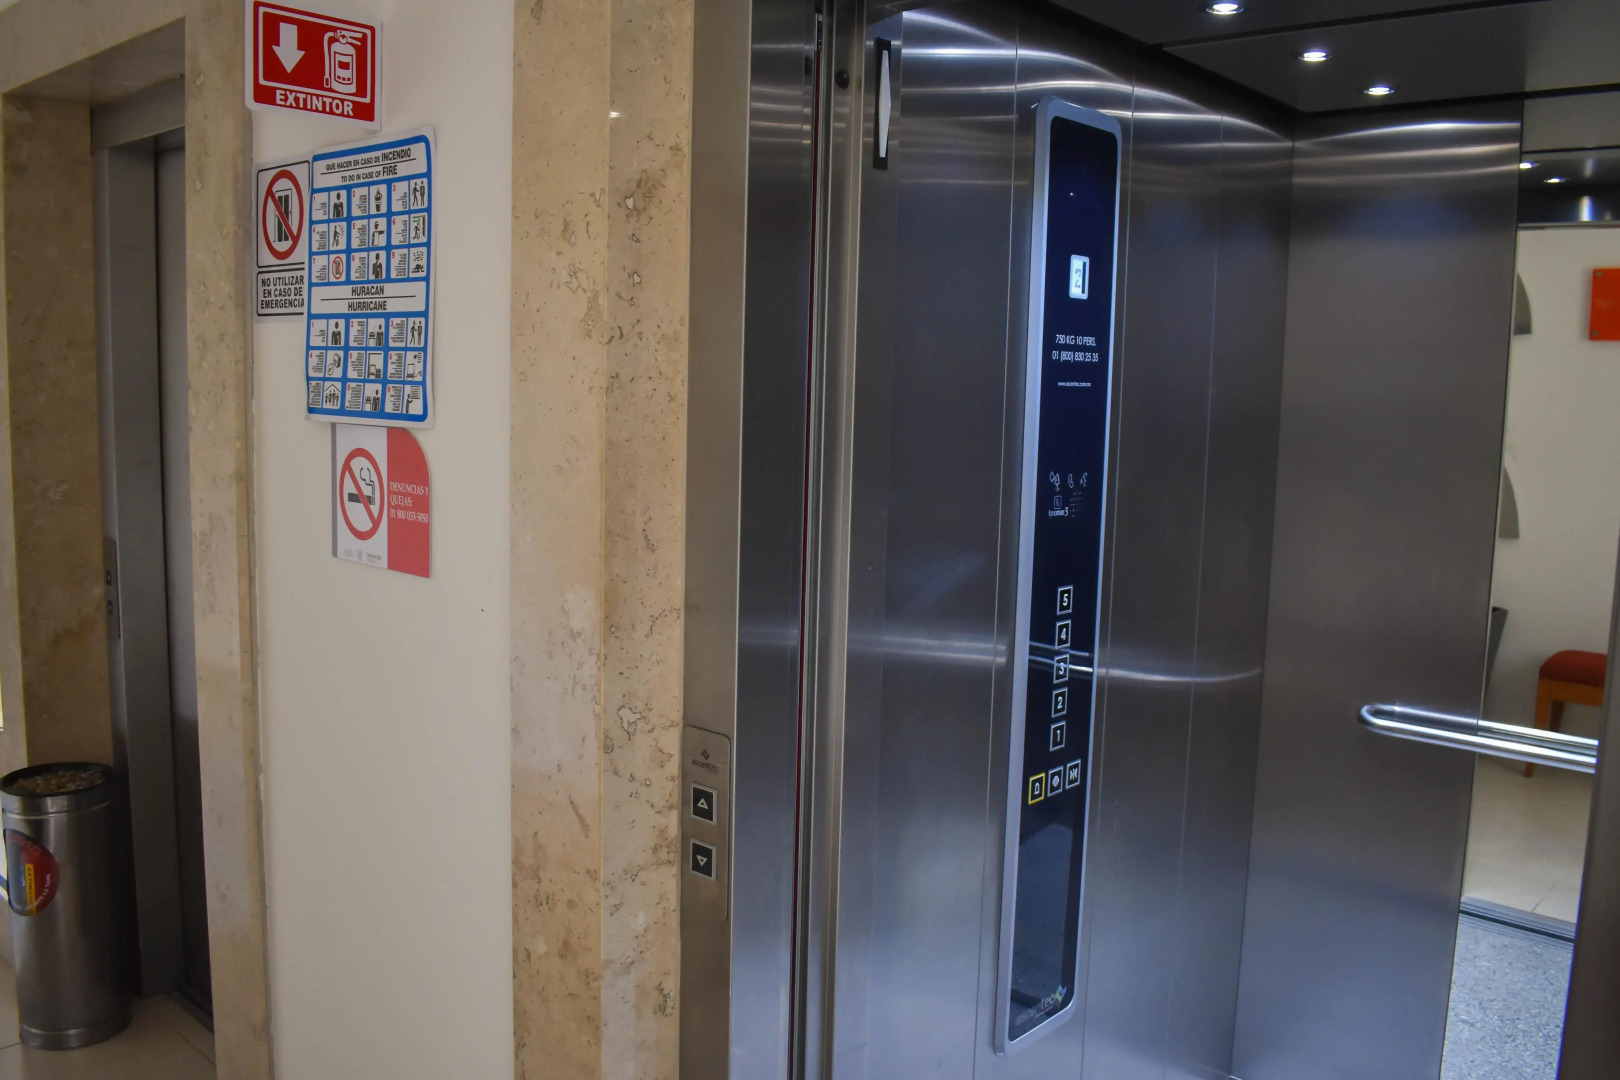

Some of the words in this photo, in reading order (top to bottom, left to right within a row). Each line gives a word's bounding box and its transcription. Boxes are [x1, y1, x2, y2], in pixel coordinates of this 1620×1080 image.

[276, 90, 353, 116] EXTINTOR
[326, 163, 336, 171] QUE
[361, 157, 374, 165] CASO
[382, 148, 411, 162] INCENDIO
[382, 165, 398, 176] FIRE
[262, 278, 271, 287] NO
[273, 275, 304, 286] UTILIZAR
[263, 289, 271, 298] EN
[274, 288, 292, 297] CASO
[294, 287, 303, 296] DE
[352, 285, 384, 296] HURACAN
[261, 298, 304, 309] EMERGENCIA
[348, 300, 387, 312] HURRICANE
[1056, 334, 1065, 344] 750
[1066, 336, 1075, 344] KG
[1077, 336, 1082, 345] 10
[1083, 337, 1096, 346] PERS.
[1052, 350, 1058, 359] 01
[1060, 351, 1073, 362] (800)
[1075, 352, 1084, 361] 830
[1085, 353, 1091, 361] 25
[1092, 353, 1098, 362] 35
[390, 482, 424, 495] DENUNCIAS
[425, 486, 429, 496] Y
[390, 494, 412, 506] QUEJAS:
[390, 508, 395, 518] 01
[397, 510, 406, 519] 800
[1062, 596, 1068, 606] 5
[1061, 629, 1066, 640] 4
[1059, 662, 1064, 674] 3
[1057, 696, 1063, 708] 2
[1056, 730, 1060, 742] 1
